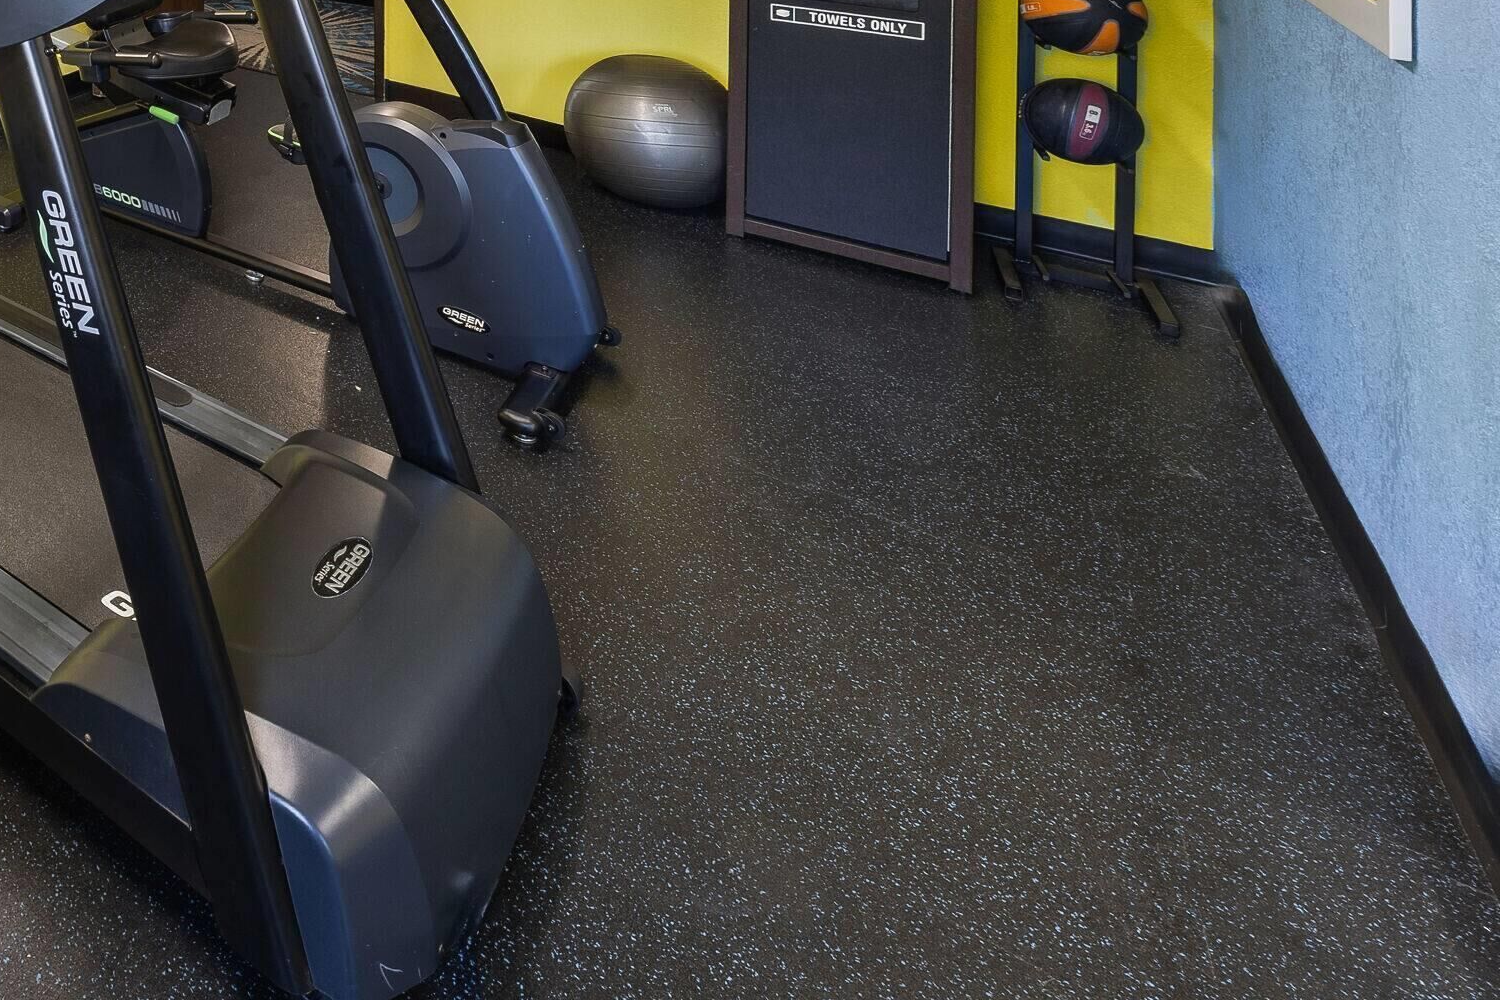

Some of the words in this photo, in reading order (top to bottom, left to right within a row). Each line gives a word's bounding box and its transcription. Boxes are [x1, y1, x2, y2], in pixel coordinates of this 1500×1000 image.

[808, 11, 866, 29] TOWELS
[870, 19, 907, 34] ONLY
[41, 189, 100, 336] GREEN
[442, 307, 485, 328] GREEN
[324, 543, 370, 594] GREEN
